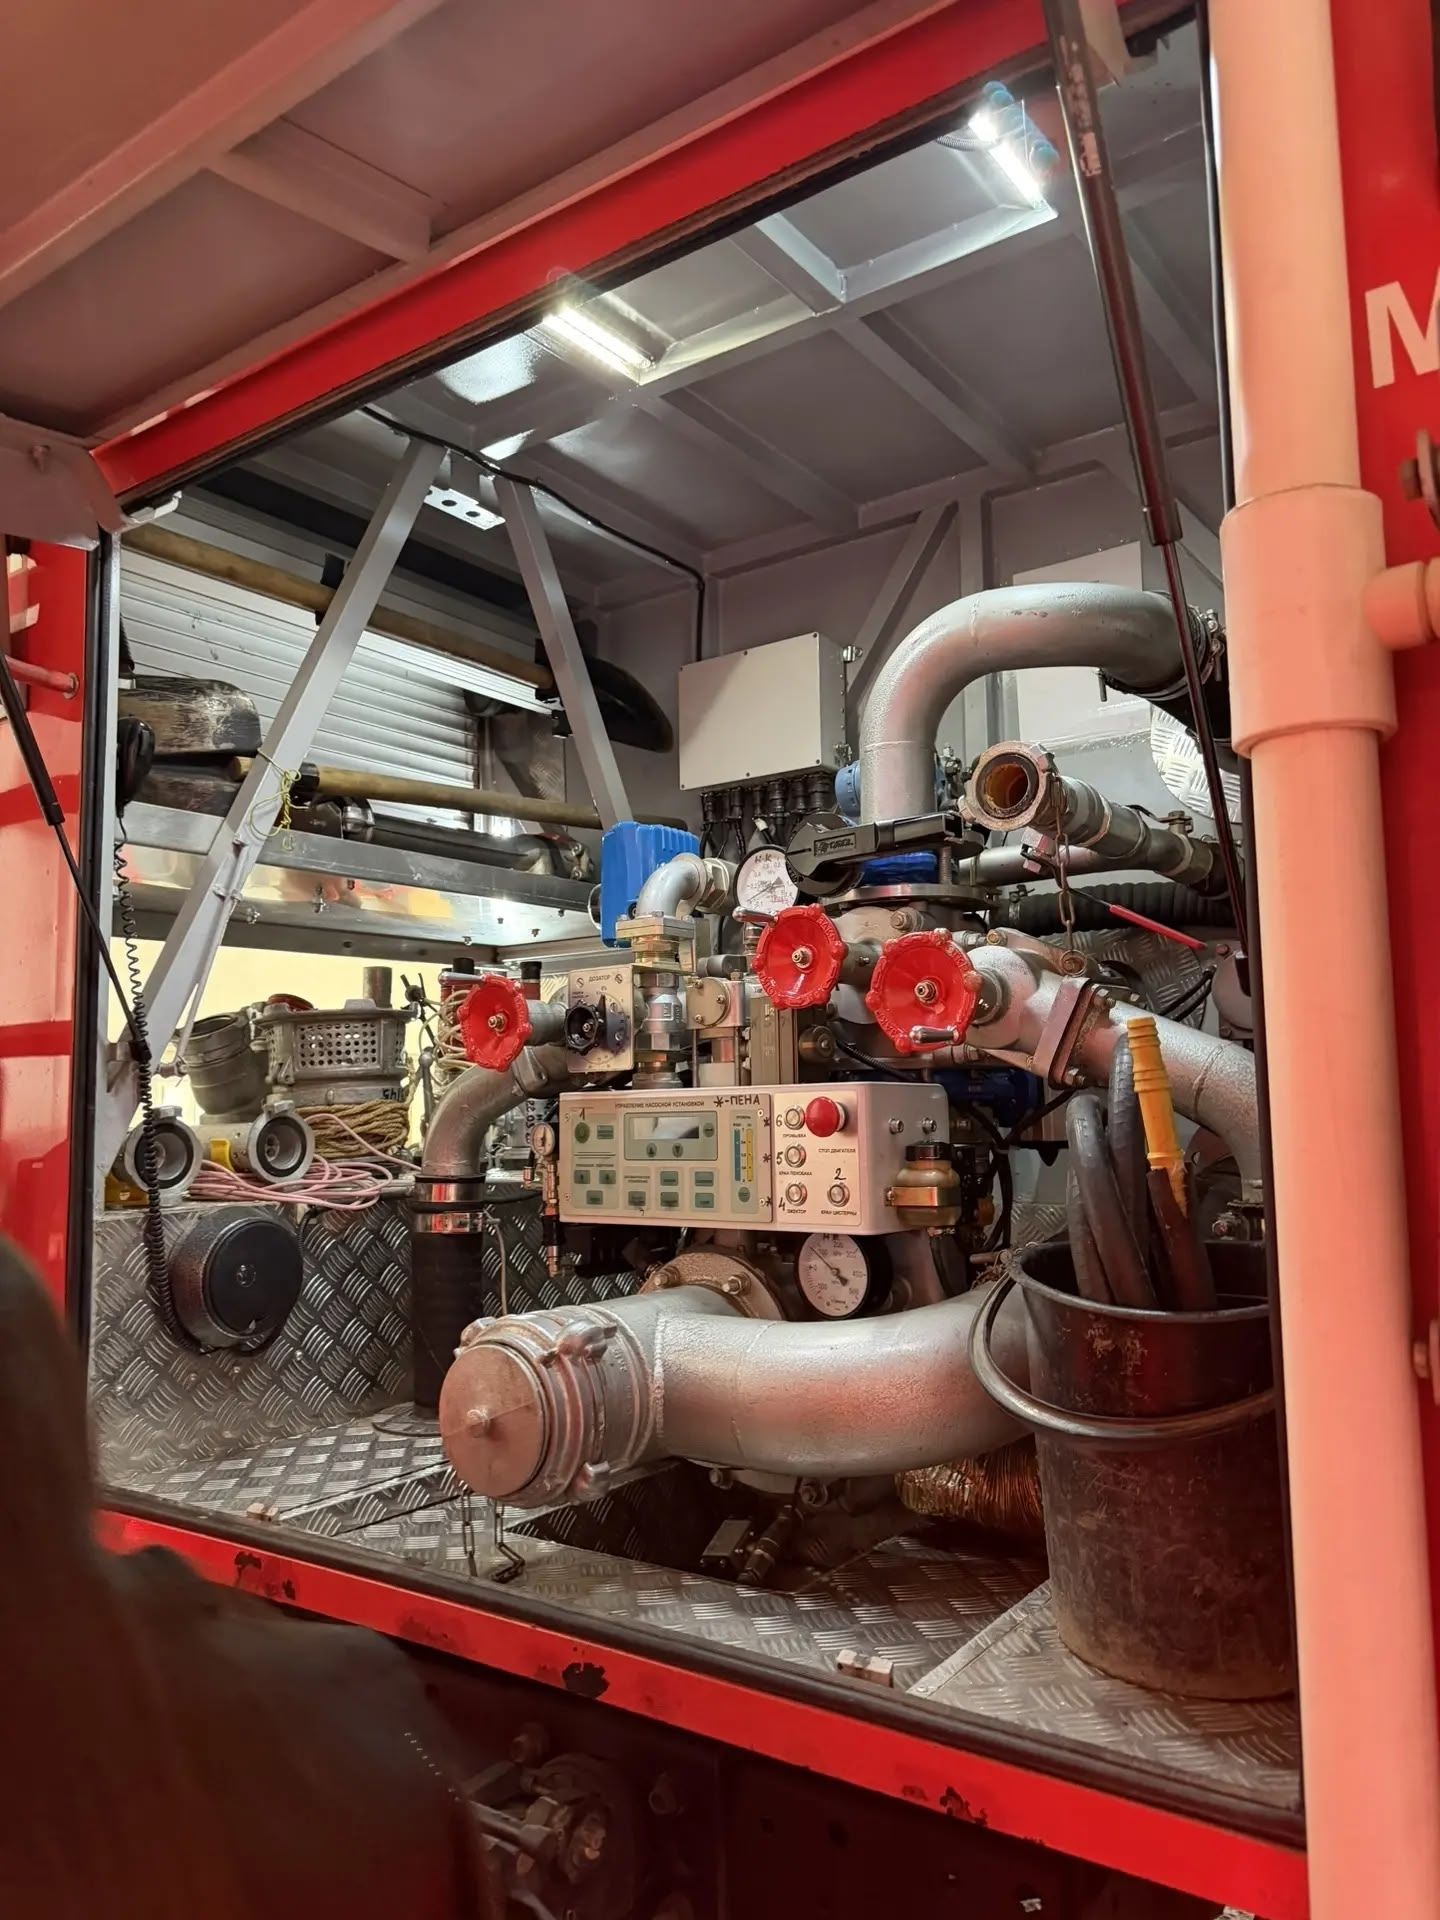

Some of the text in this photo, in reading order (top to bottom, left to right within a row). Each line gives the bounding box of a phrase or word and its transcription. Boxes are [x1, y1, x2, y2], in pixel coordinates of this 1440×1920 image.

[775, 1114, 783, 1127] 6
[776, 1151, 783, 1166] 5
[834, 1167, 847, 1180] 2
[778, 1197, 786, 1211] 4
